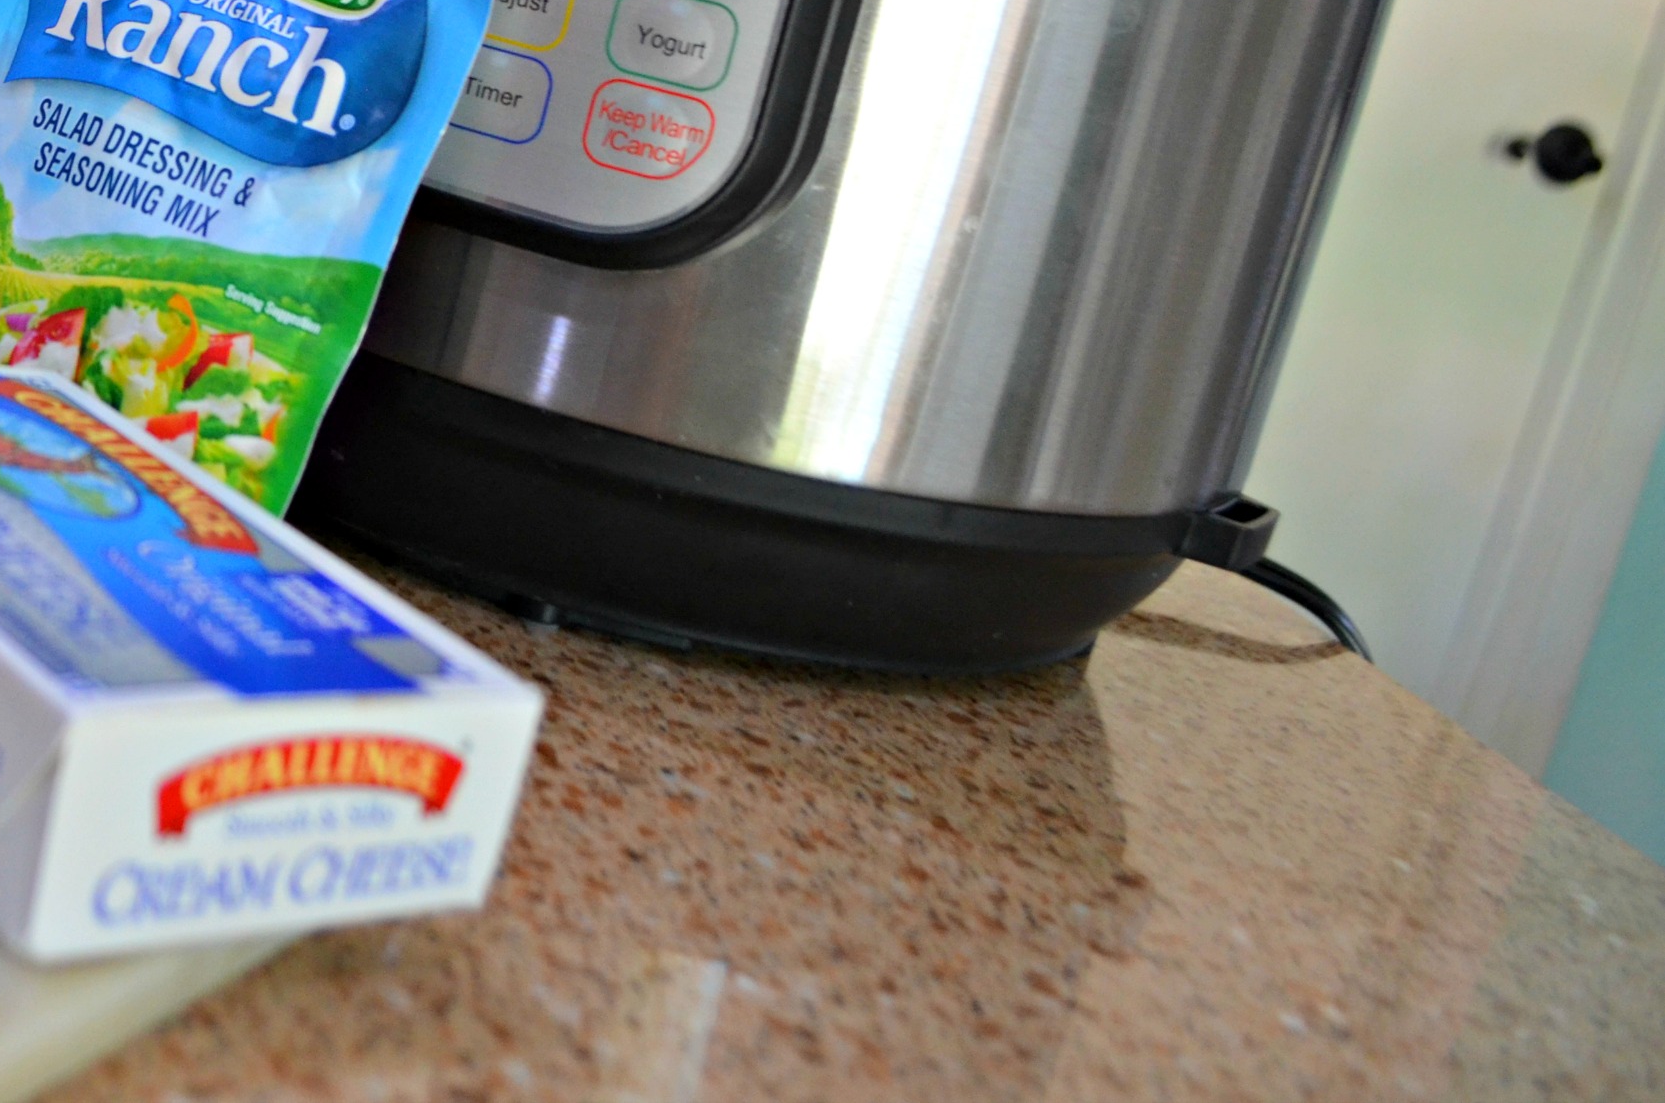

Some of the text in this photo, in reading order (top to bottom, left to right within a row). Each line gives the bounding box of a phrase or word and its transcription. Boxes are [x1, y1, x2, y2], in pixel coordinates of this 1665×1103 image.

[637, 24, 706, 60] Yogurt
[465, 76, 523, 108] Timer
[599, 100, 705, 144] Keep Warm
[33, 98, 255, 207] SALAD DRESSING &
[601, 129, 686, 167] /Cancel
[34, 142, 220, 237] SEASONING MIX
[92, 853, 281, 929] CREAM
